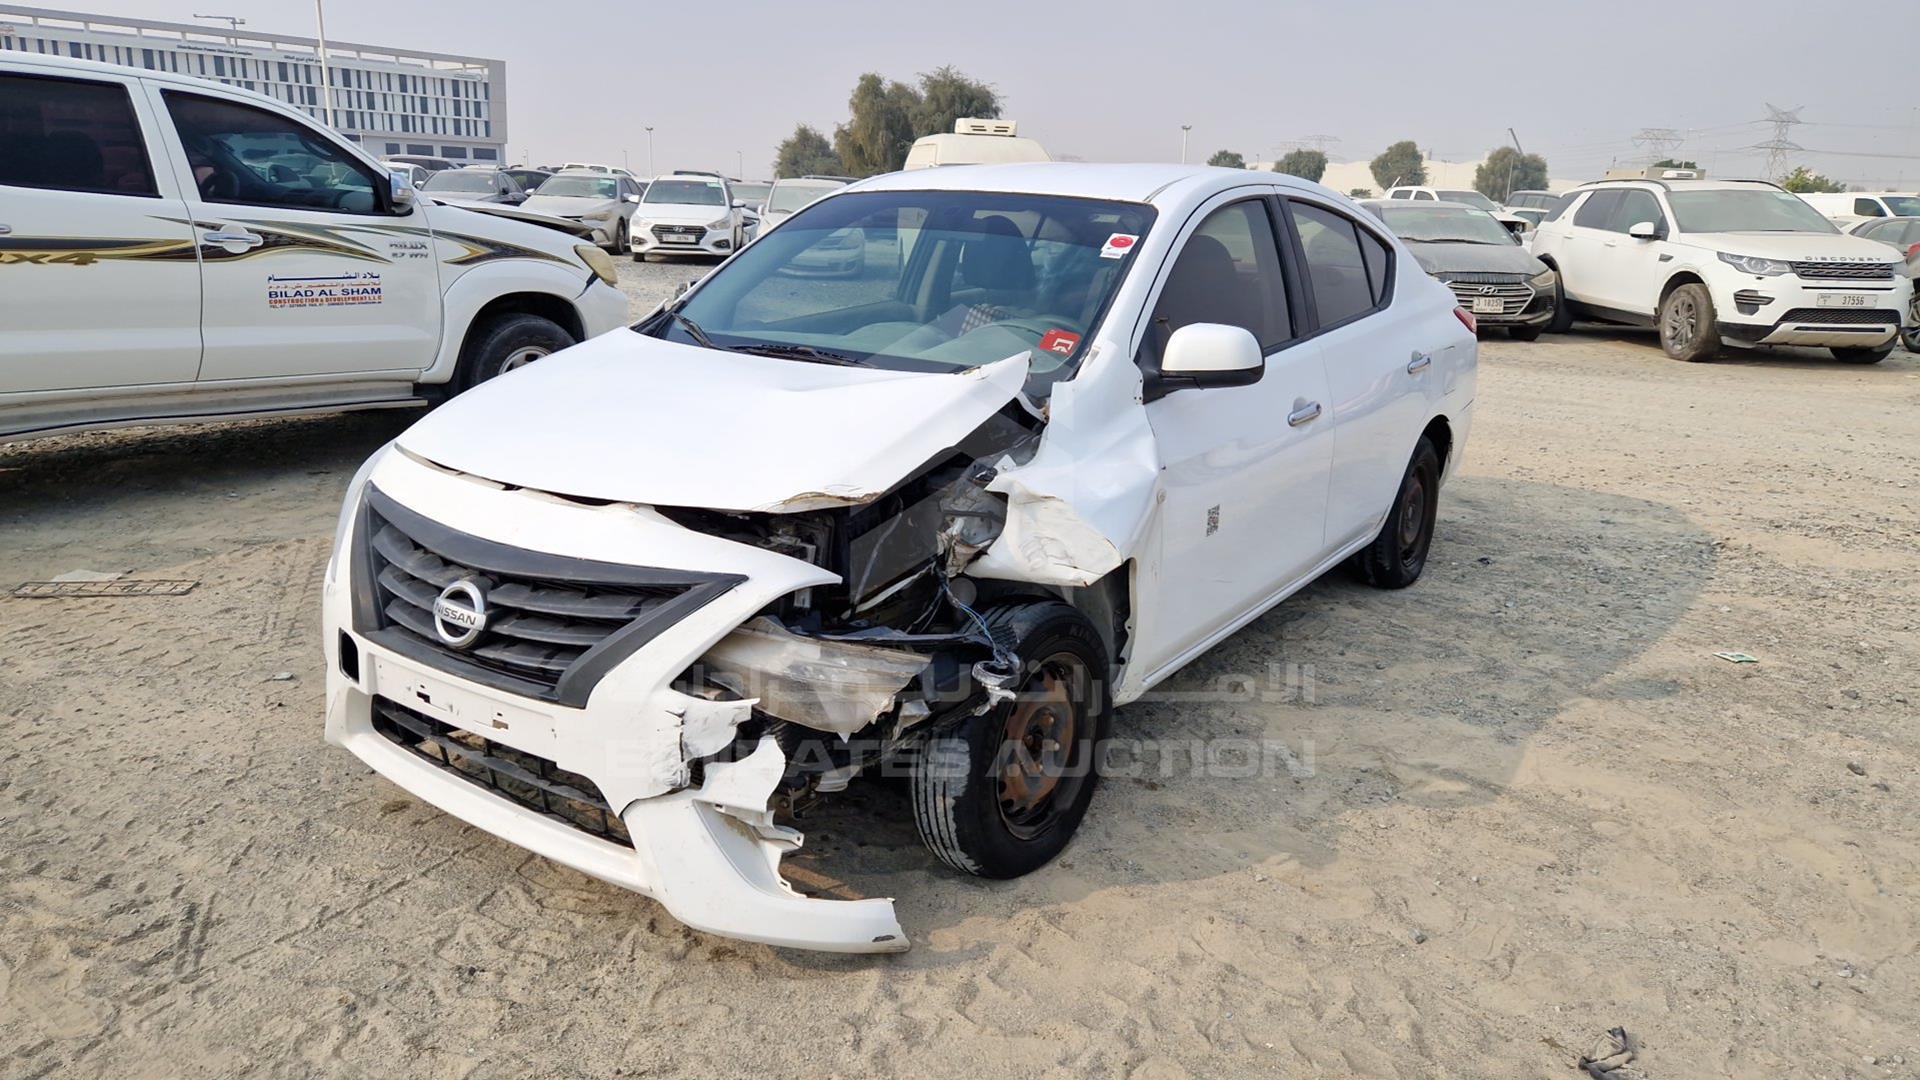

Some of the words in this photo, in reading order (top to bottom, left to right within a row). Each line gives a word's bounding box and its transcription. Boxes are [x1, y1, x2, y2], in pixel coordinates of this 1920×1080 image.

[268, 289, 314, 299] BILAD
[318, 288, 338, 297] AL
[341, 287, 381, 296] SHAM
[436, 602, 476, 625] NISSAN
